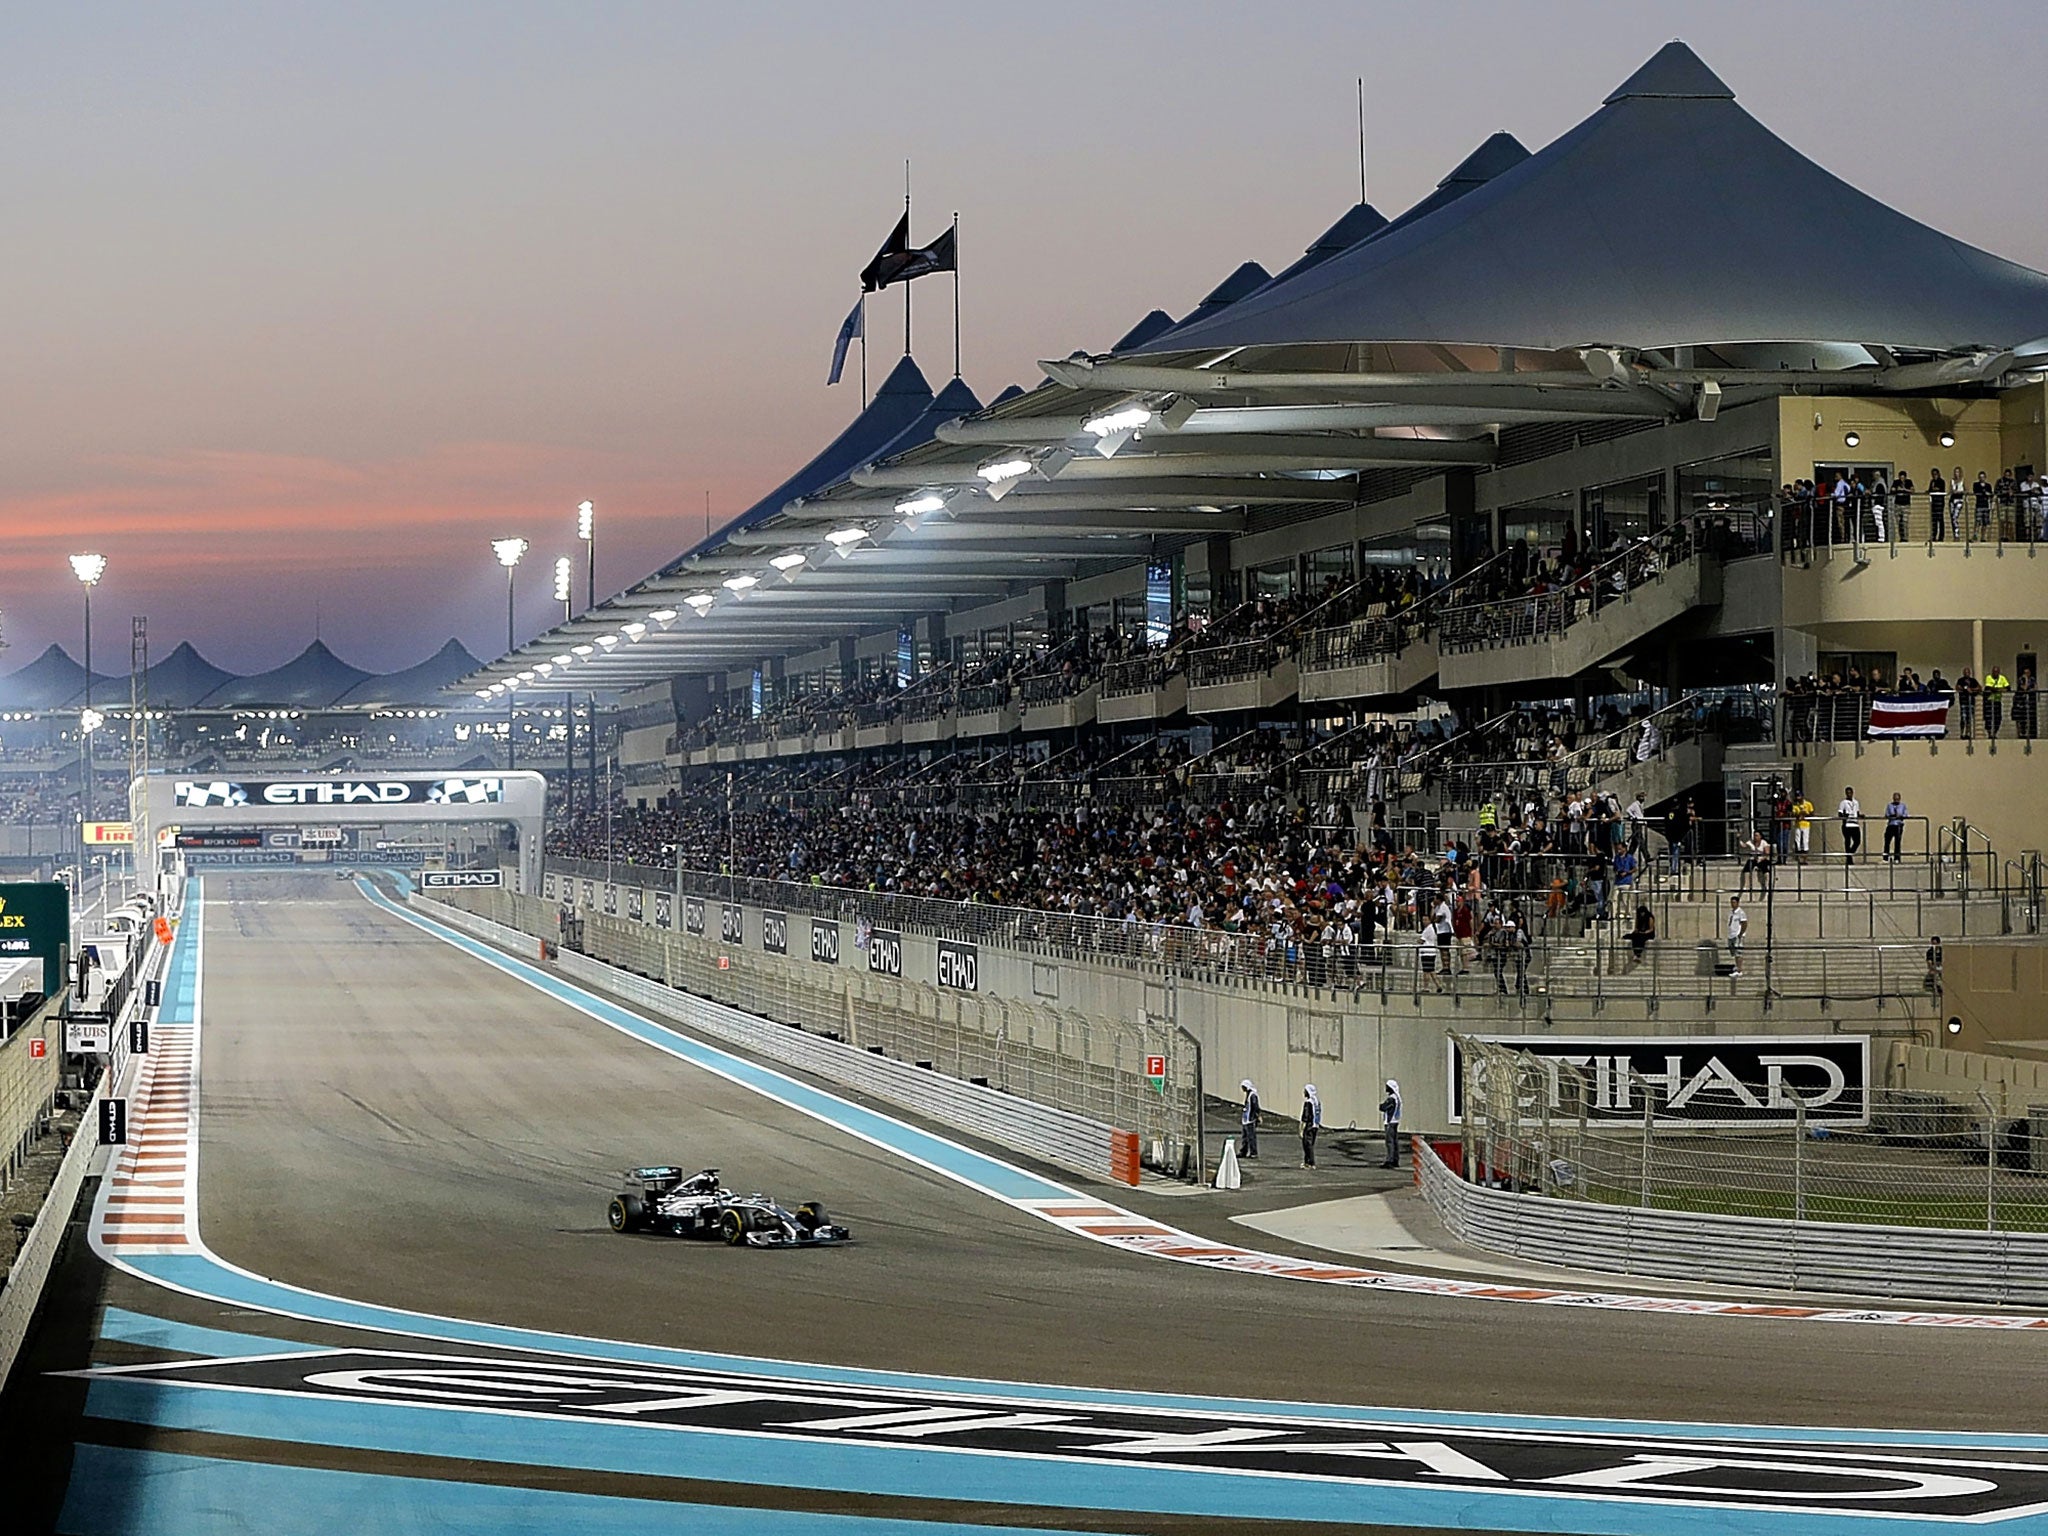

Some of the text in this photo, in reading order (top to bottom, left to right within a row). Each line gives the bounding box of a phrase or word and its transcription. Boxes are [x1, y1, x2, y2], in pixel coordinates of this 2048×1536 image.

[263, 783, 410, 803] ETIHAD
[429, 874, 495, 885] ETIHAD
[764, 918, 786, 948] ETIHAD
[813, 927, 838, 960] ETIHAD
[870, 938, 900, 973] ETIHAD
[939, 950, 976, 990] ETIHAD
[83, 1027, 107, 1038] UBS
[33, 1042, 42, 1057] F
[1151, 1059, 1161, 1074] F
[303, 1369, 1998, 1499] ETIHAD
